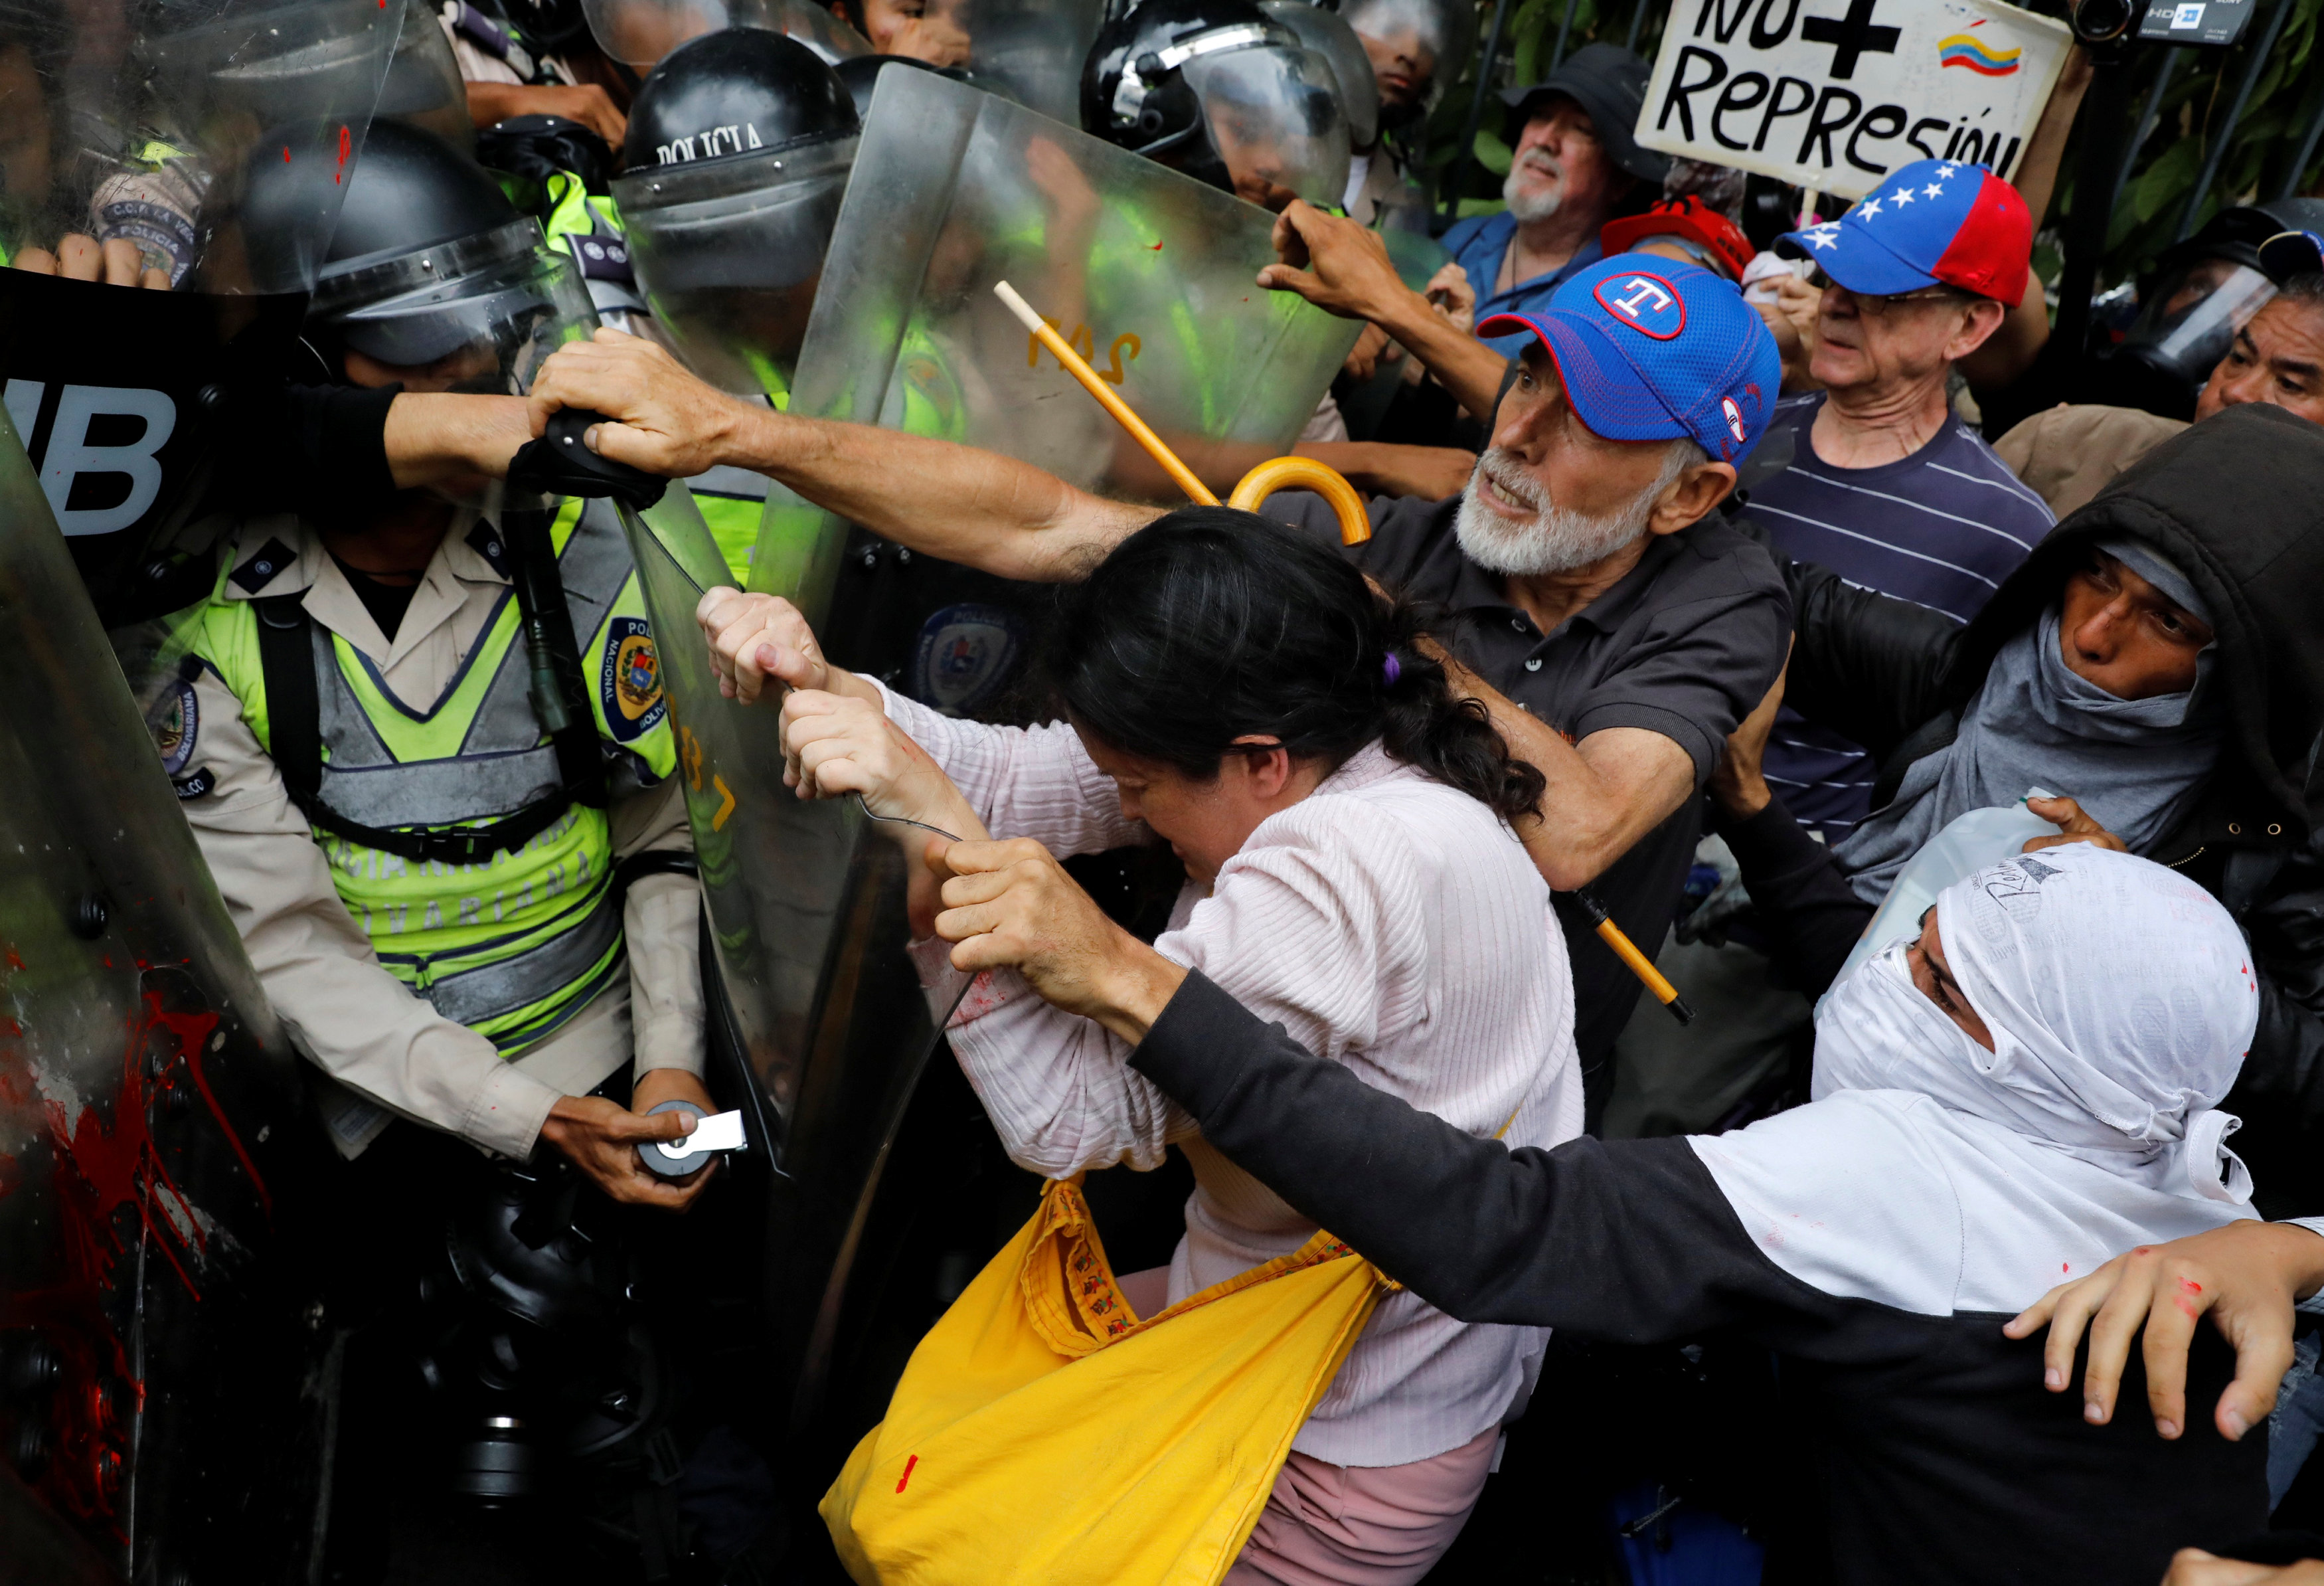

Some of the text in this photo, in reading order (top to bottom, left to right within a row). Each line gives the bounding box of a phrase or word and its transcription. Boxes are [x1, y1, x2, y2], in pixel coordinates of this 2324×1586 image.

[1612, 277, 1674, 319] T
[600, 639, 620, 704] NACIONAL
[177, 691, 197, 762] BOLIVARIANA
